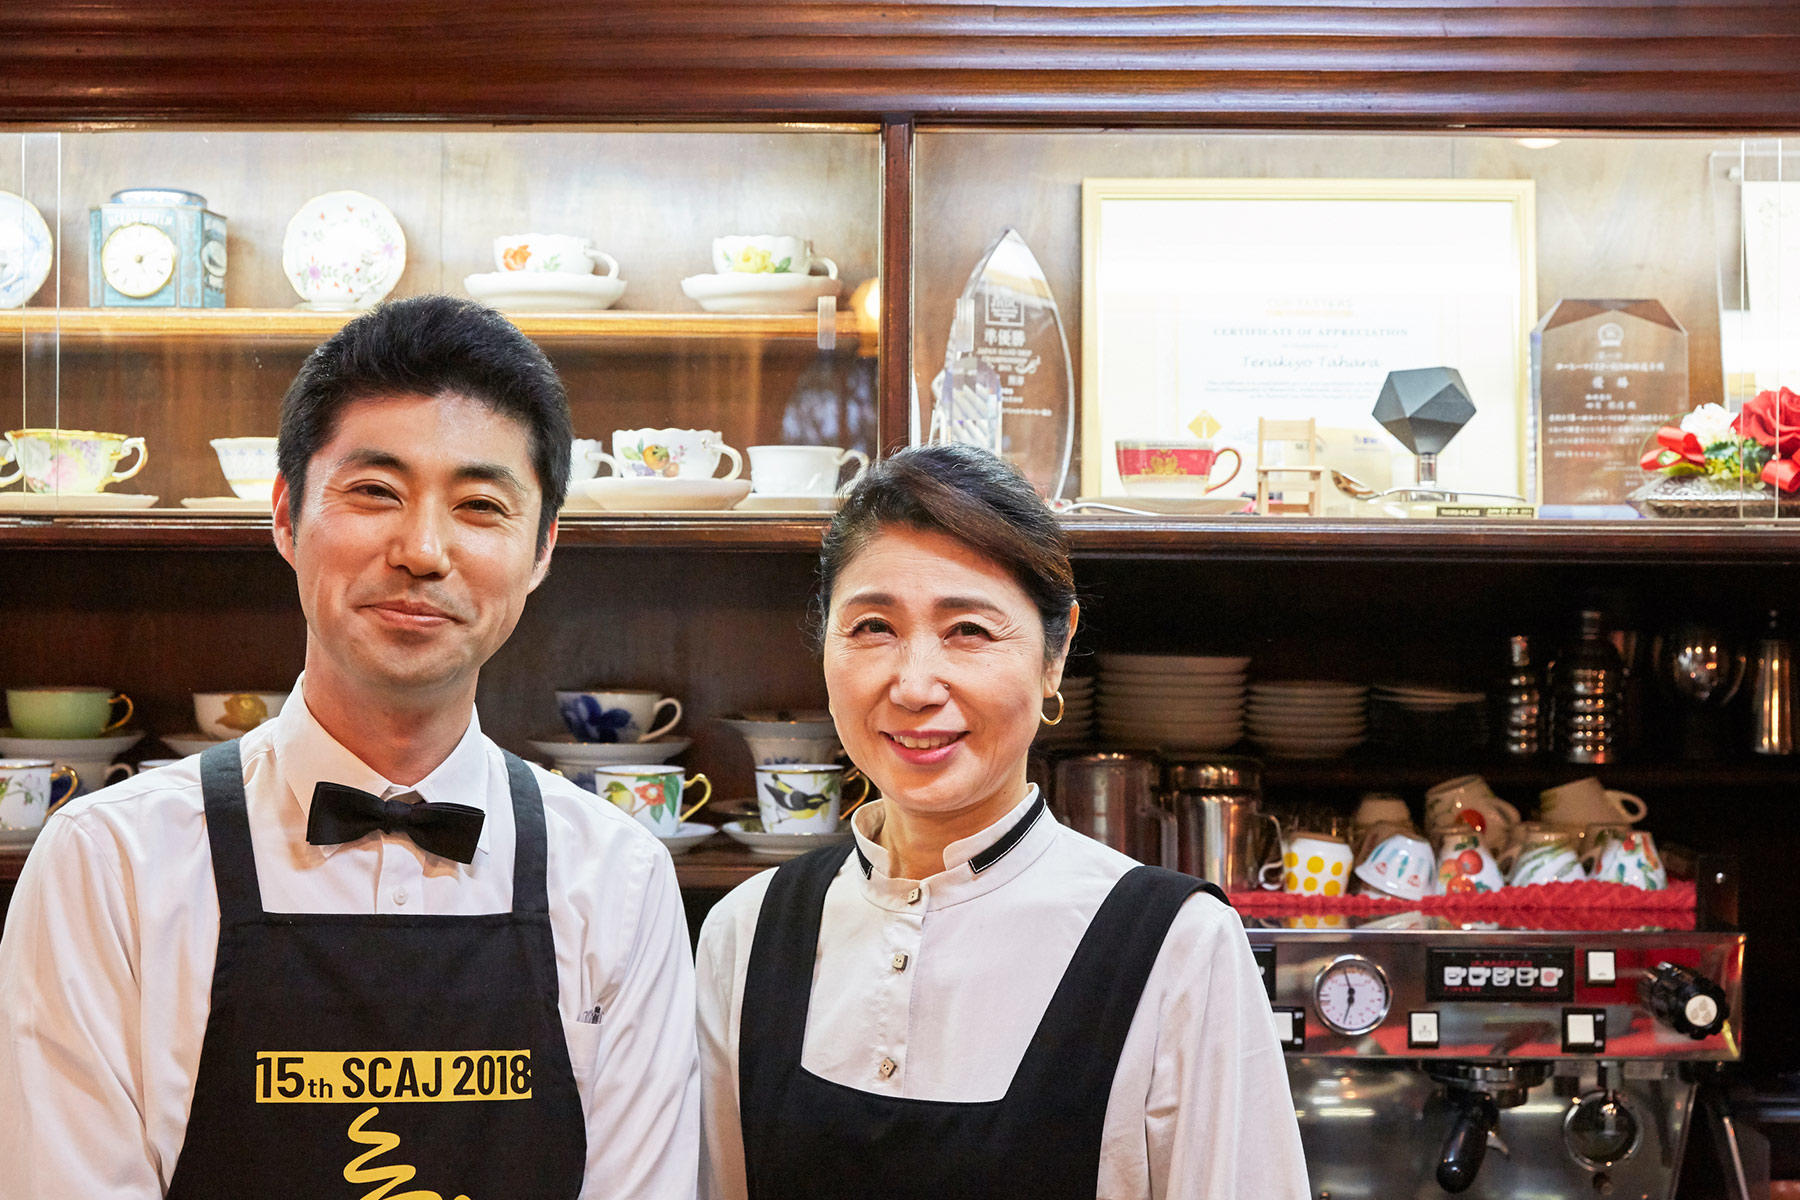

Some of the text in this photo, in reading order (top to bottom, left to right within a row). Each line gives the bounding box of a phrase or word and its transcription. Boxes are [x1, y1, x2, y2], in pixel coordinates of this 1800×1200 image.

[1213, 328, 1408, 337] CERTIFICATE OF APPRECIATION
[256, 1055, 532, 1098] 15th SCAJ 2018
